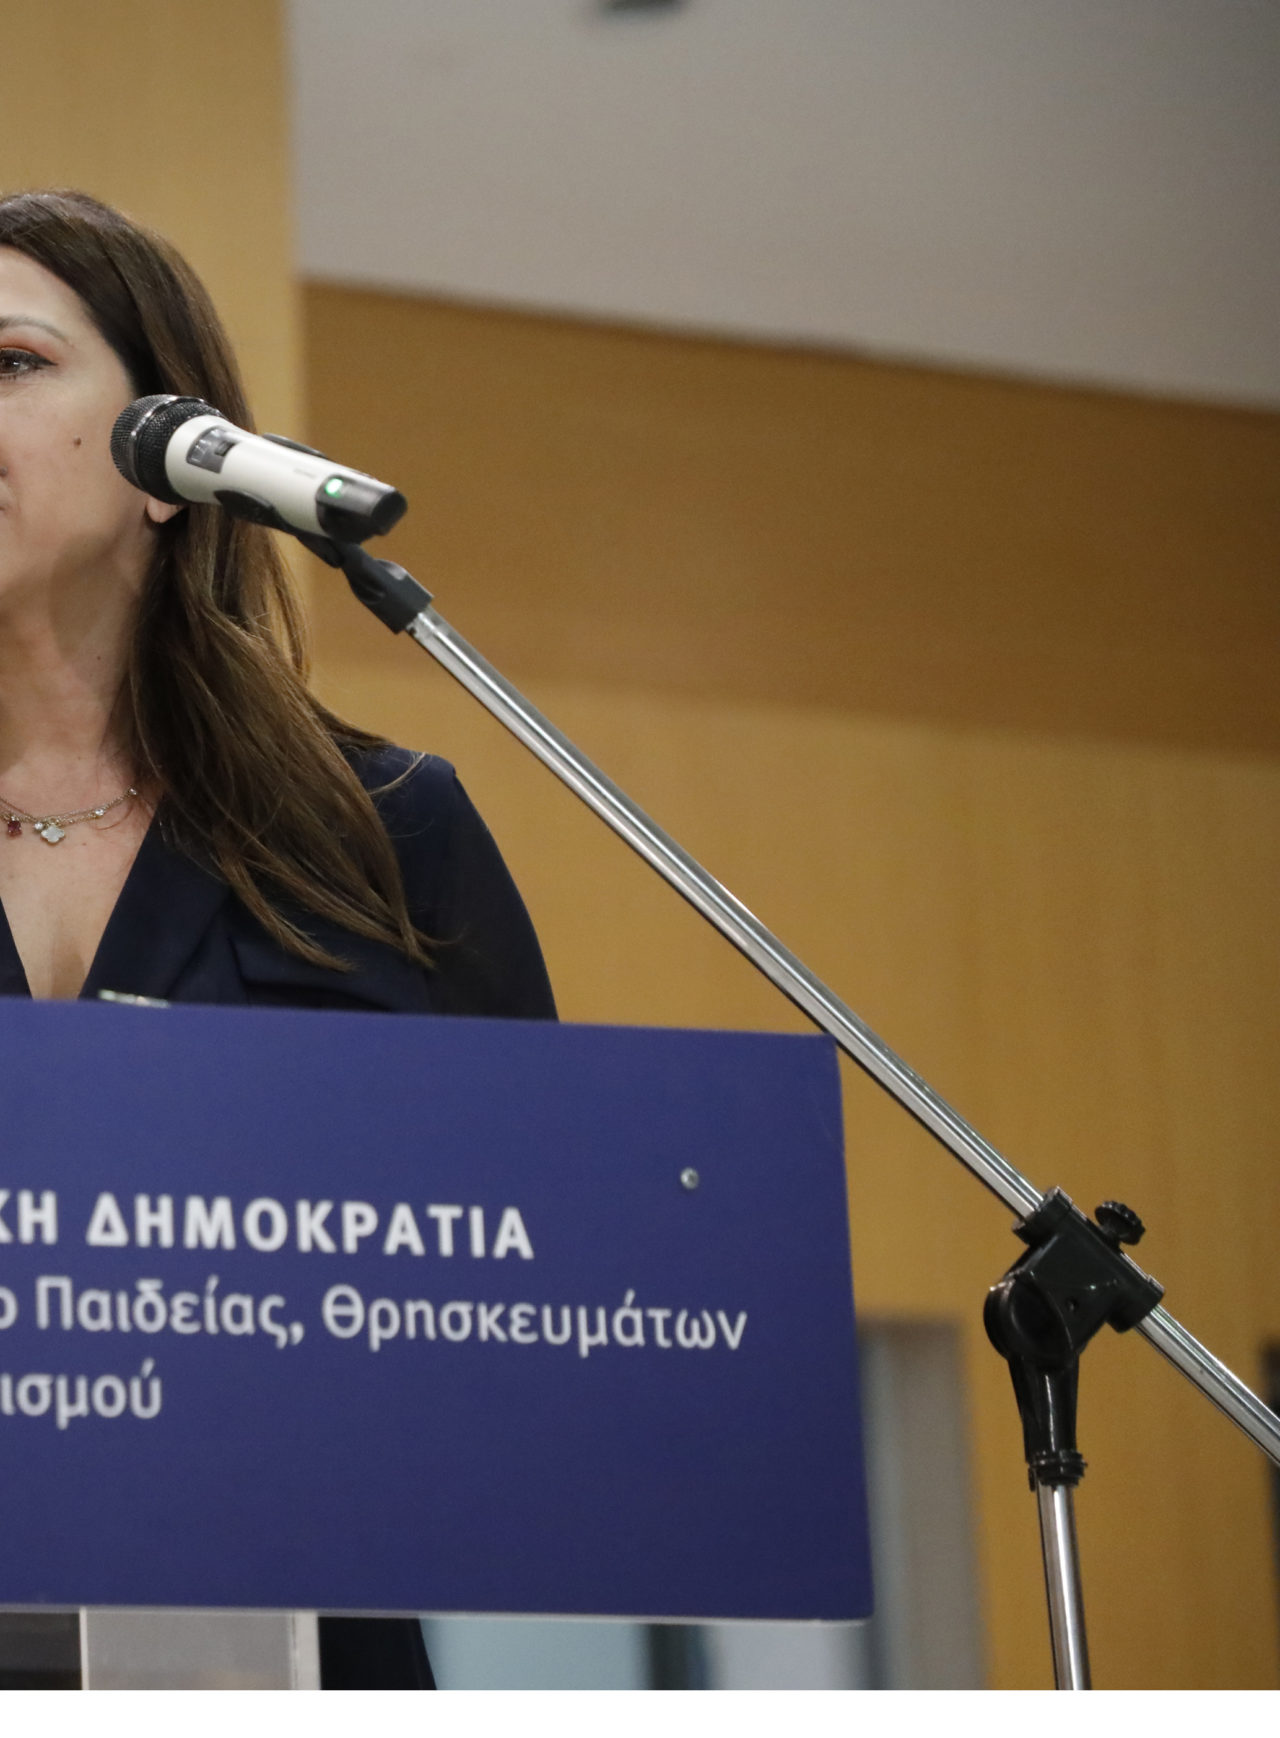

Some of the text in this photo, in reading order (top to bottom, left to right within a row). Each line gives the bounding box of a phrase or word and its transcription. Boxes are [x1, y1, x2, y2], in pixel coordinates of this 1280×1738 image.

[85, 1191, 534, 1260] ΔΗΜΟΚΡΑΤΙΑ
[35, 1275, 305, 1349] Παιδείας,
[321, 1284, 748, 1358] Θρησκευμάτων
